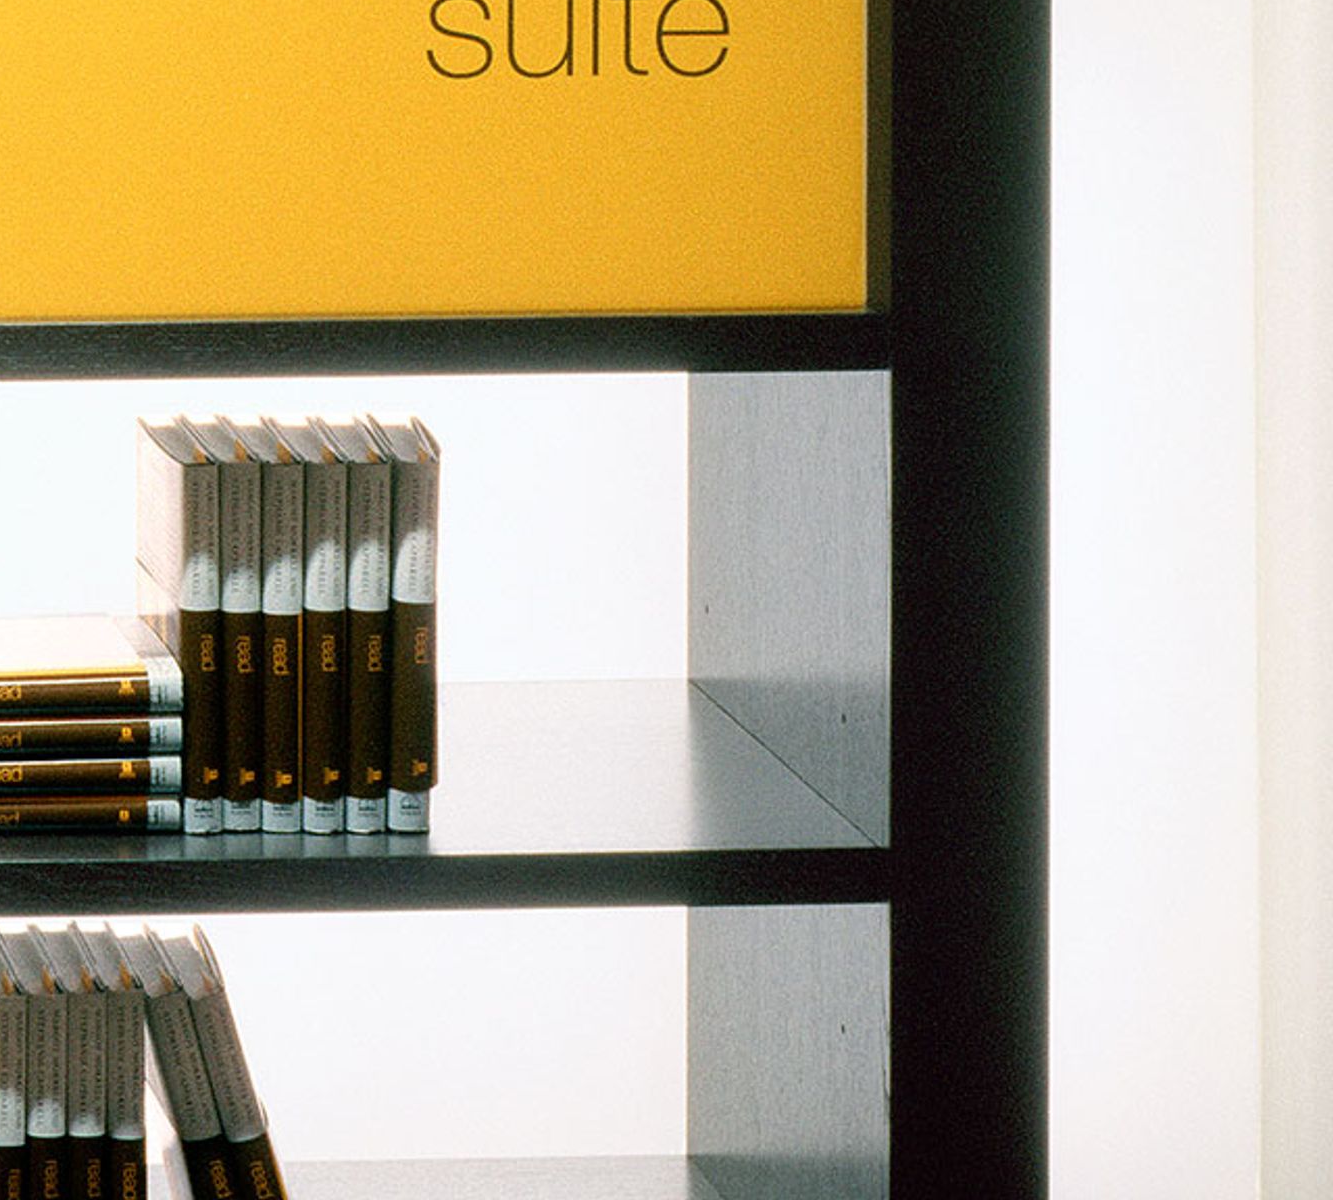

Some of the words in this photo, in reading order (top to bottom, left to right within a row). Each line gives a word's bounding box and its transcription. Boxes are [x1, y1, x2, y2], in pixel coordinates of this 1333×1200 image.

[200, 633, 214, 672] read
[237, 635, 254, 674] read
[273, 637, 288, 676] read
[320, 634, 336, 673] read
[367, 635, 383, 673] read
[415, 627, 428, 664] read
